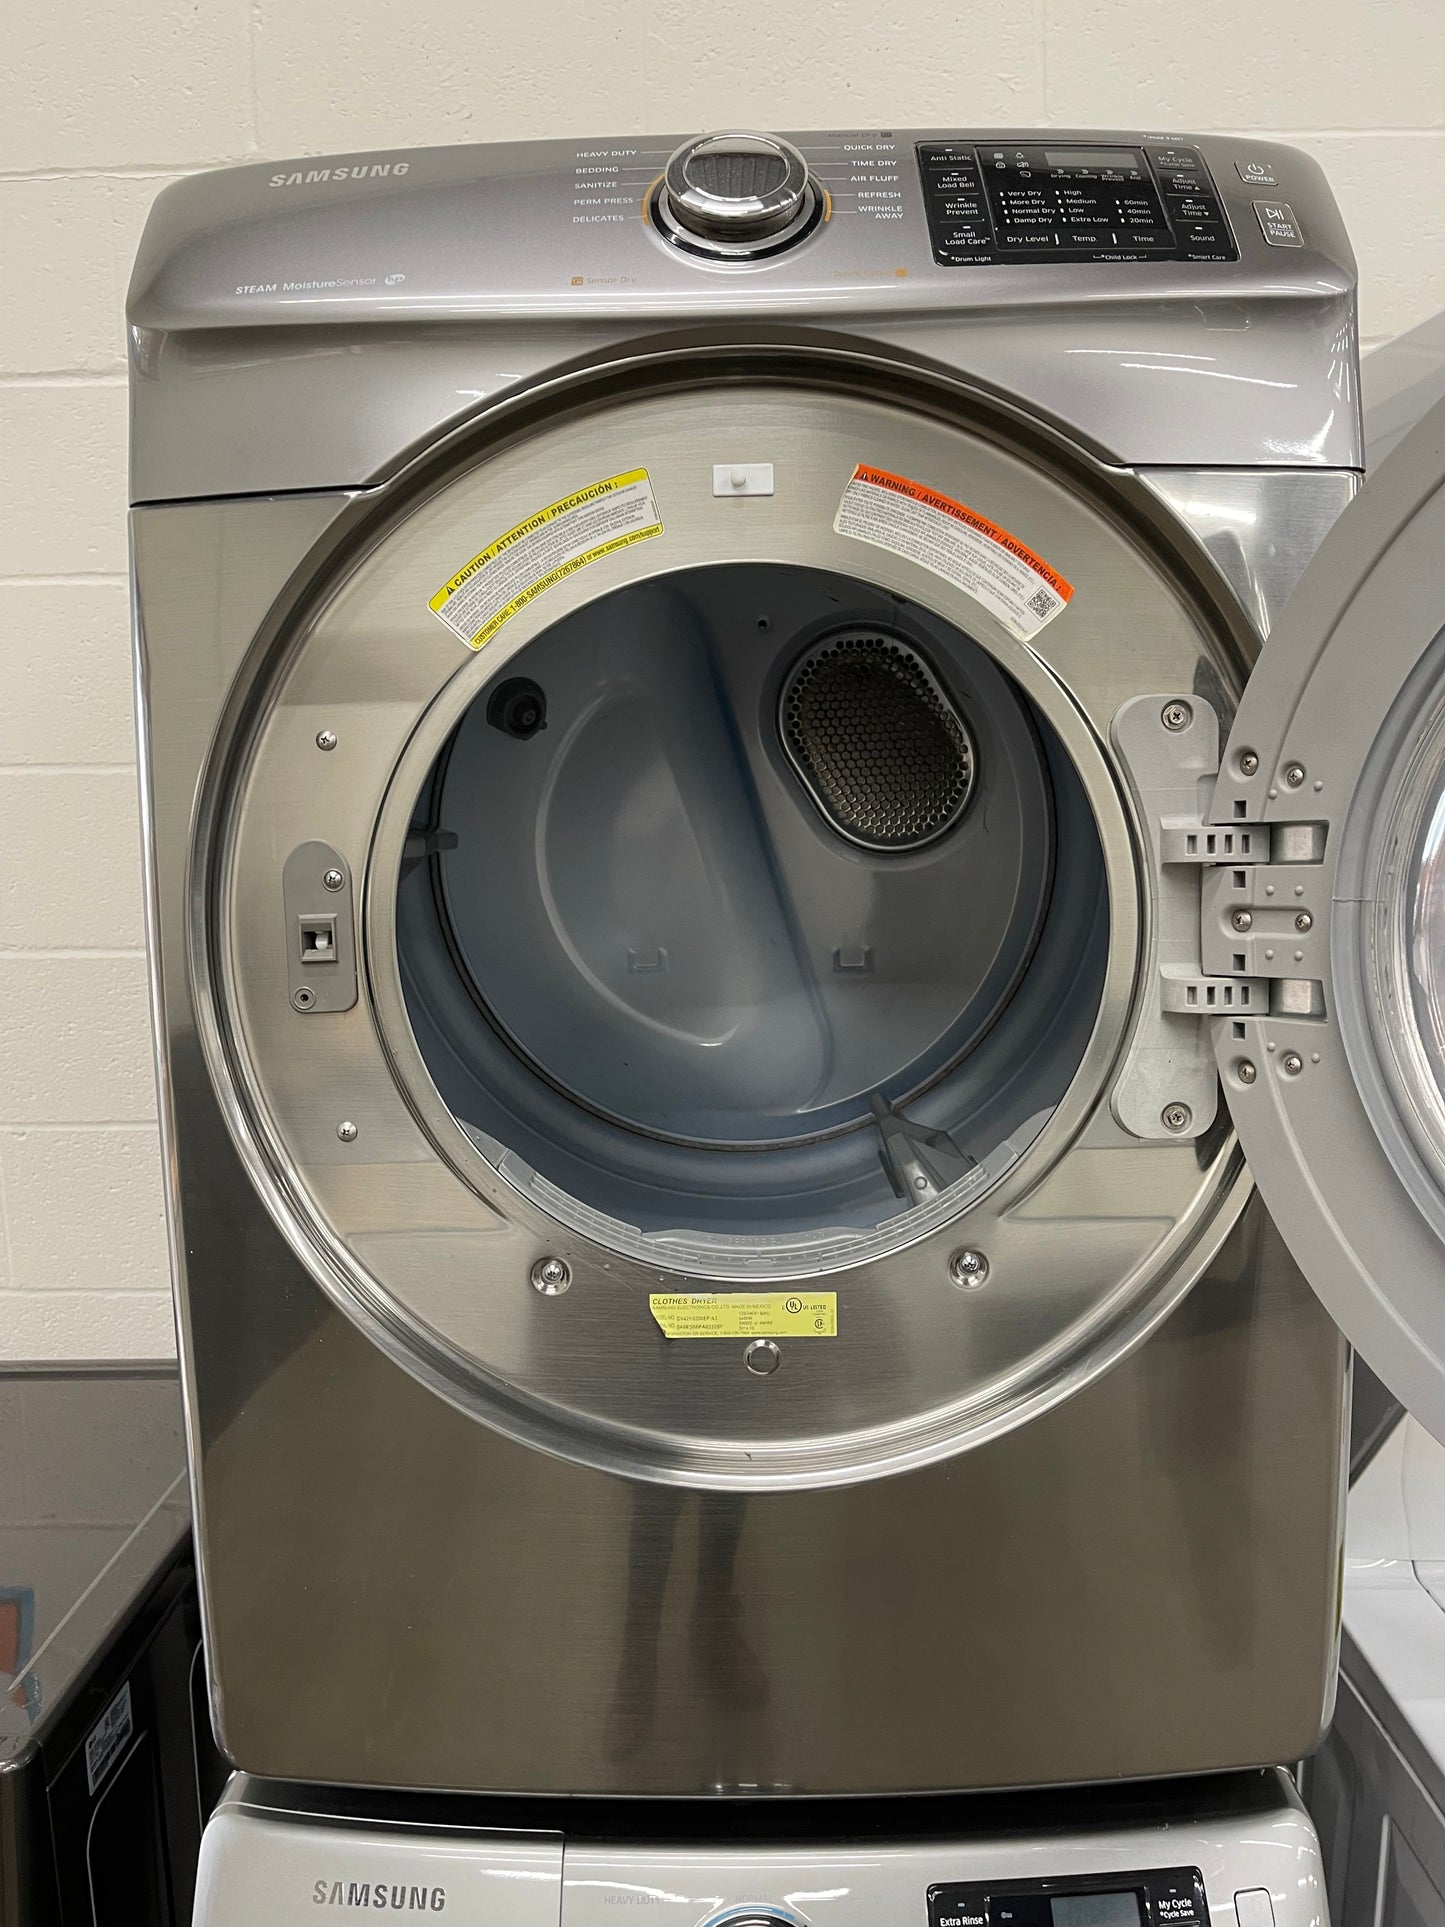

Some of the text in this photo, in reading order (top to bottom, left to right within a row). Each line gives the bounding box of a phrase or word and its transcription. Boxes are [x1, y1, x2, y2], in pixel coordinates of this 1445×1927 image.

[844, 144, 872, 152] QUICK
[576, 166, 619, 174] BEDDING
[268, 163, 410, 188] SAMSUNG
[1245, 174, 1275, 182] POWER
[1172, 178, 1196, 186] Adjust
[1182, 203, 1206, 211] Adjust
[1126, 208, 1151, 216] 40min
[573, 215, 624, 223] DELICATES
[1267, 222, 1292, 230] START
[1190, 234, 1215, 242] Sound
[1270, 230, 1296, 238] PAUSE
[1006, 236, 1024, 244] Dry
[236, 284, 277, 295] STEAM
[282, 278, 377, 292] MoistureSensor
[454, 553, 492, 587] CAUTION
[496, 515, 546, 552] ATTENTION
[551, 481, 613, 518] PRECAUCIÓN
[870, 473, 916, 497] WARNING
[922, 494, 998, 538] AVERTISSEMENT
[1001, 537, 1058, 588] ADVERTENCIA
[312, 1879, 446, 1912] SAMSUNG
[604, 1895, 635, 1905] HEAVY
[1158, 1898, 1192, 1911] My Cycle
[1180, 1908, 1194, 1917] Save
[940, 1914, 984, 1927] Extra Rinse
